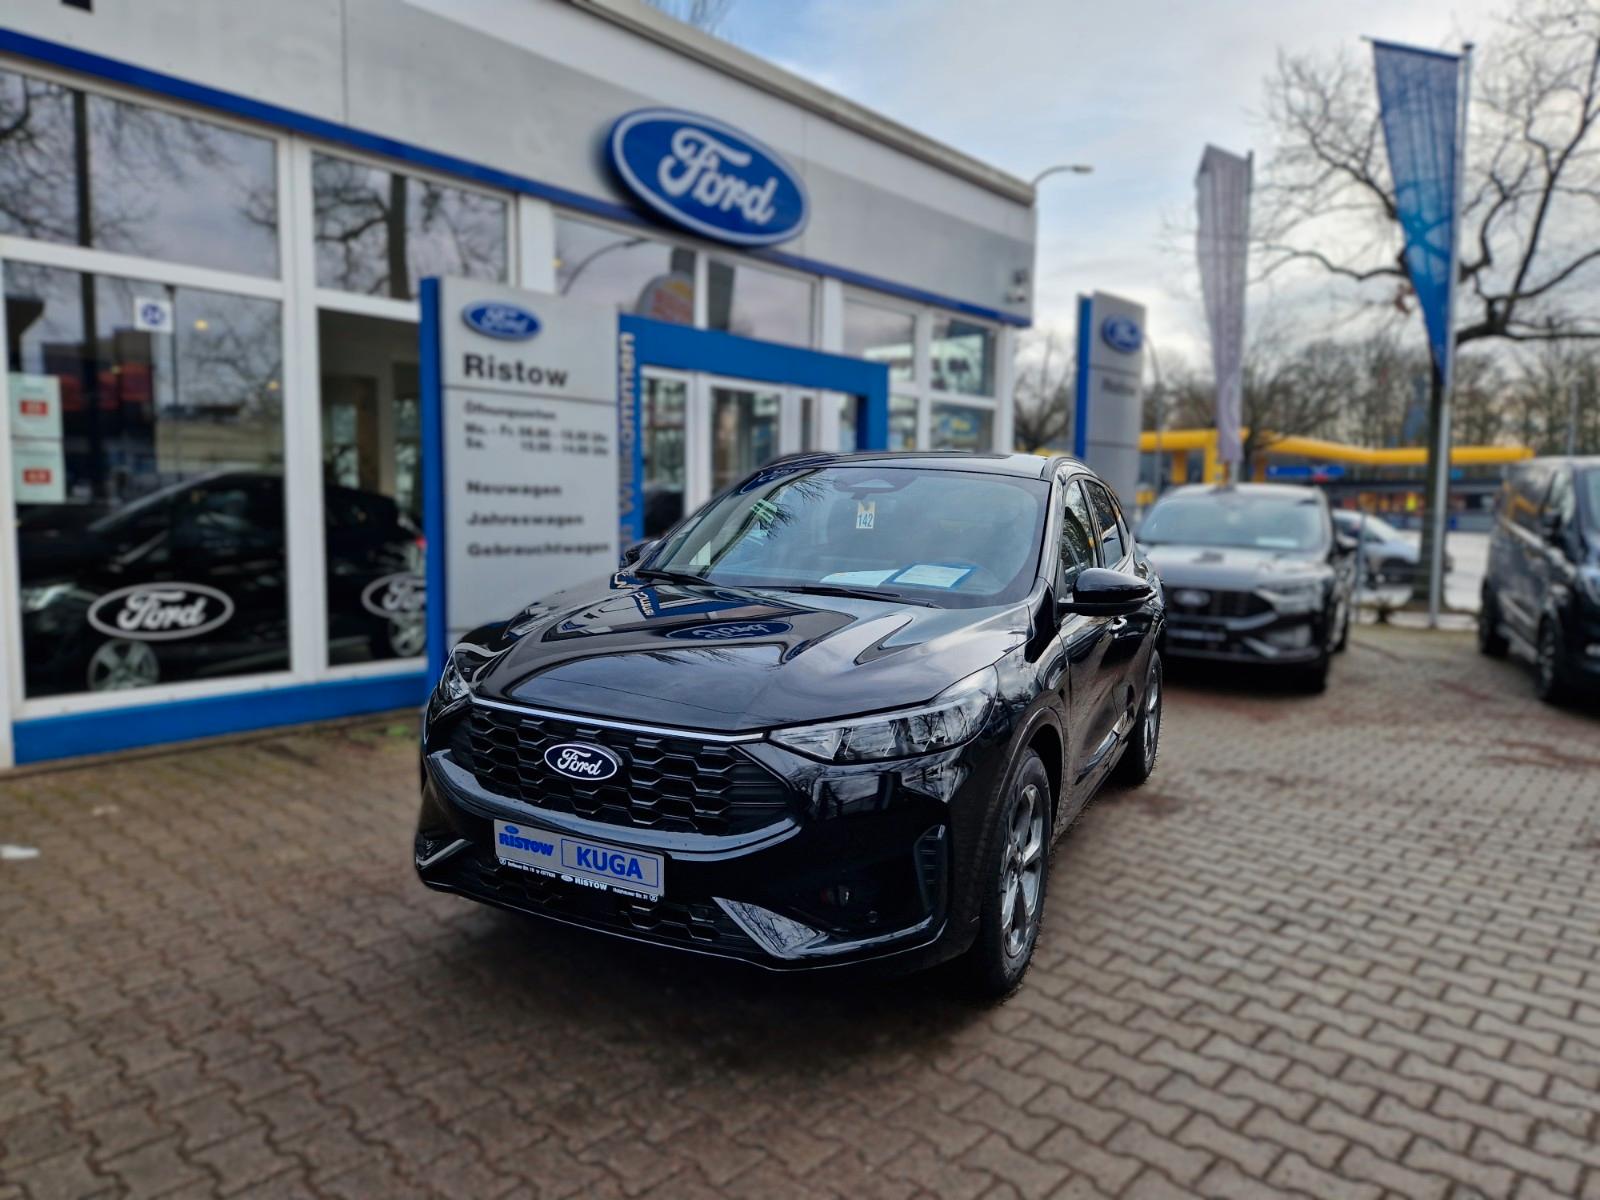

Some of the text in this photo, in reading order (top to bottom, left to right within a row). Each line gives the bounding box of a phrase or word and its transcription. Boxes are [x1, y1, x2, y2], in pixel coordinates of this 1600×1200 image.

[657, 127, 778, 224] Ford
[480, 308, 530, 334] Ford
[463, 354, 568, 386] Ristow
[466, 481, 562, 498] Neuwagen
[467, 513, 584, 529] Jahreswagen
[857, 513, 873, 527] 142
[467, 543, 609, 558] Gebrauchtwagen
[383, 577, 427, 610] For
[117, 590, 206, 630] Ford
[557, 748, 603, 776] Ford
[498, 832, 554, 857] RISTOW
[576, 846, 643, 880] KUGA
[574, 877, 608, 891] RISTOW
